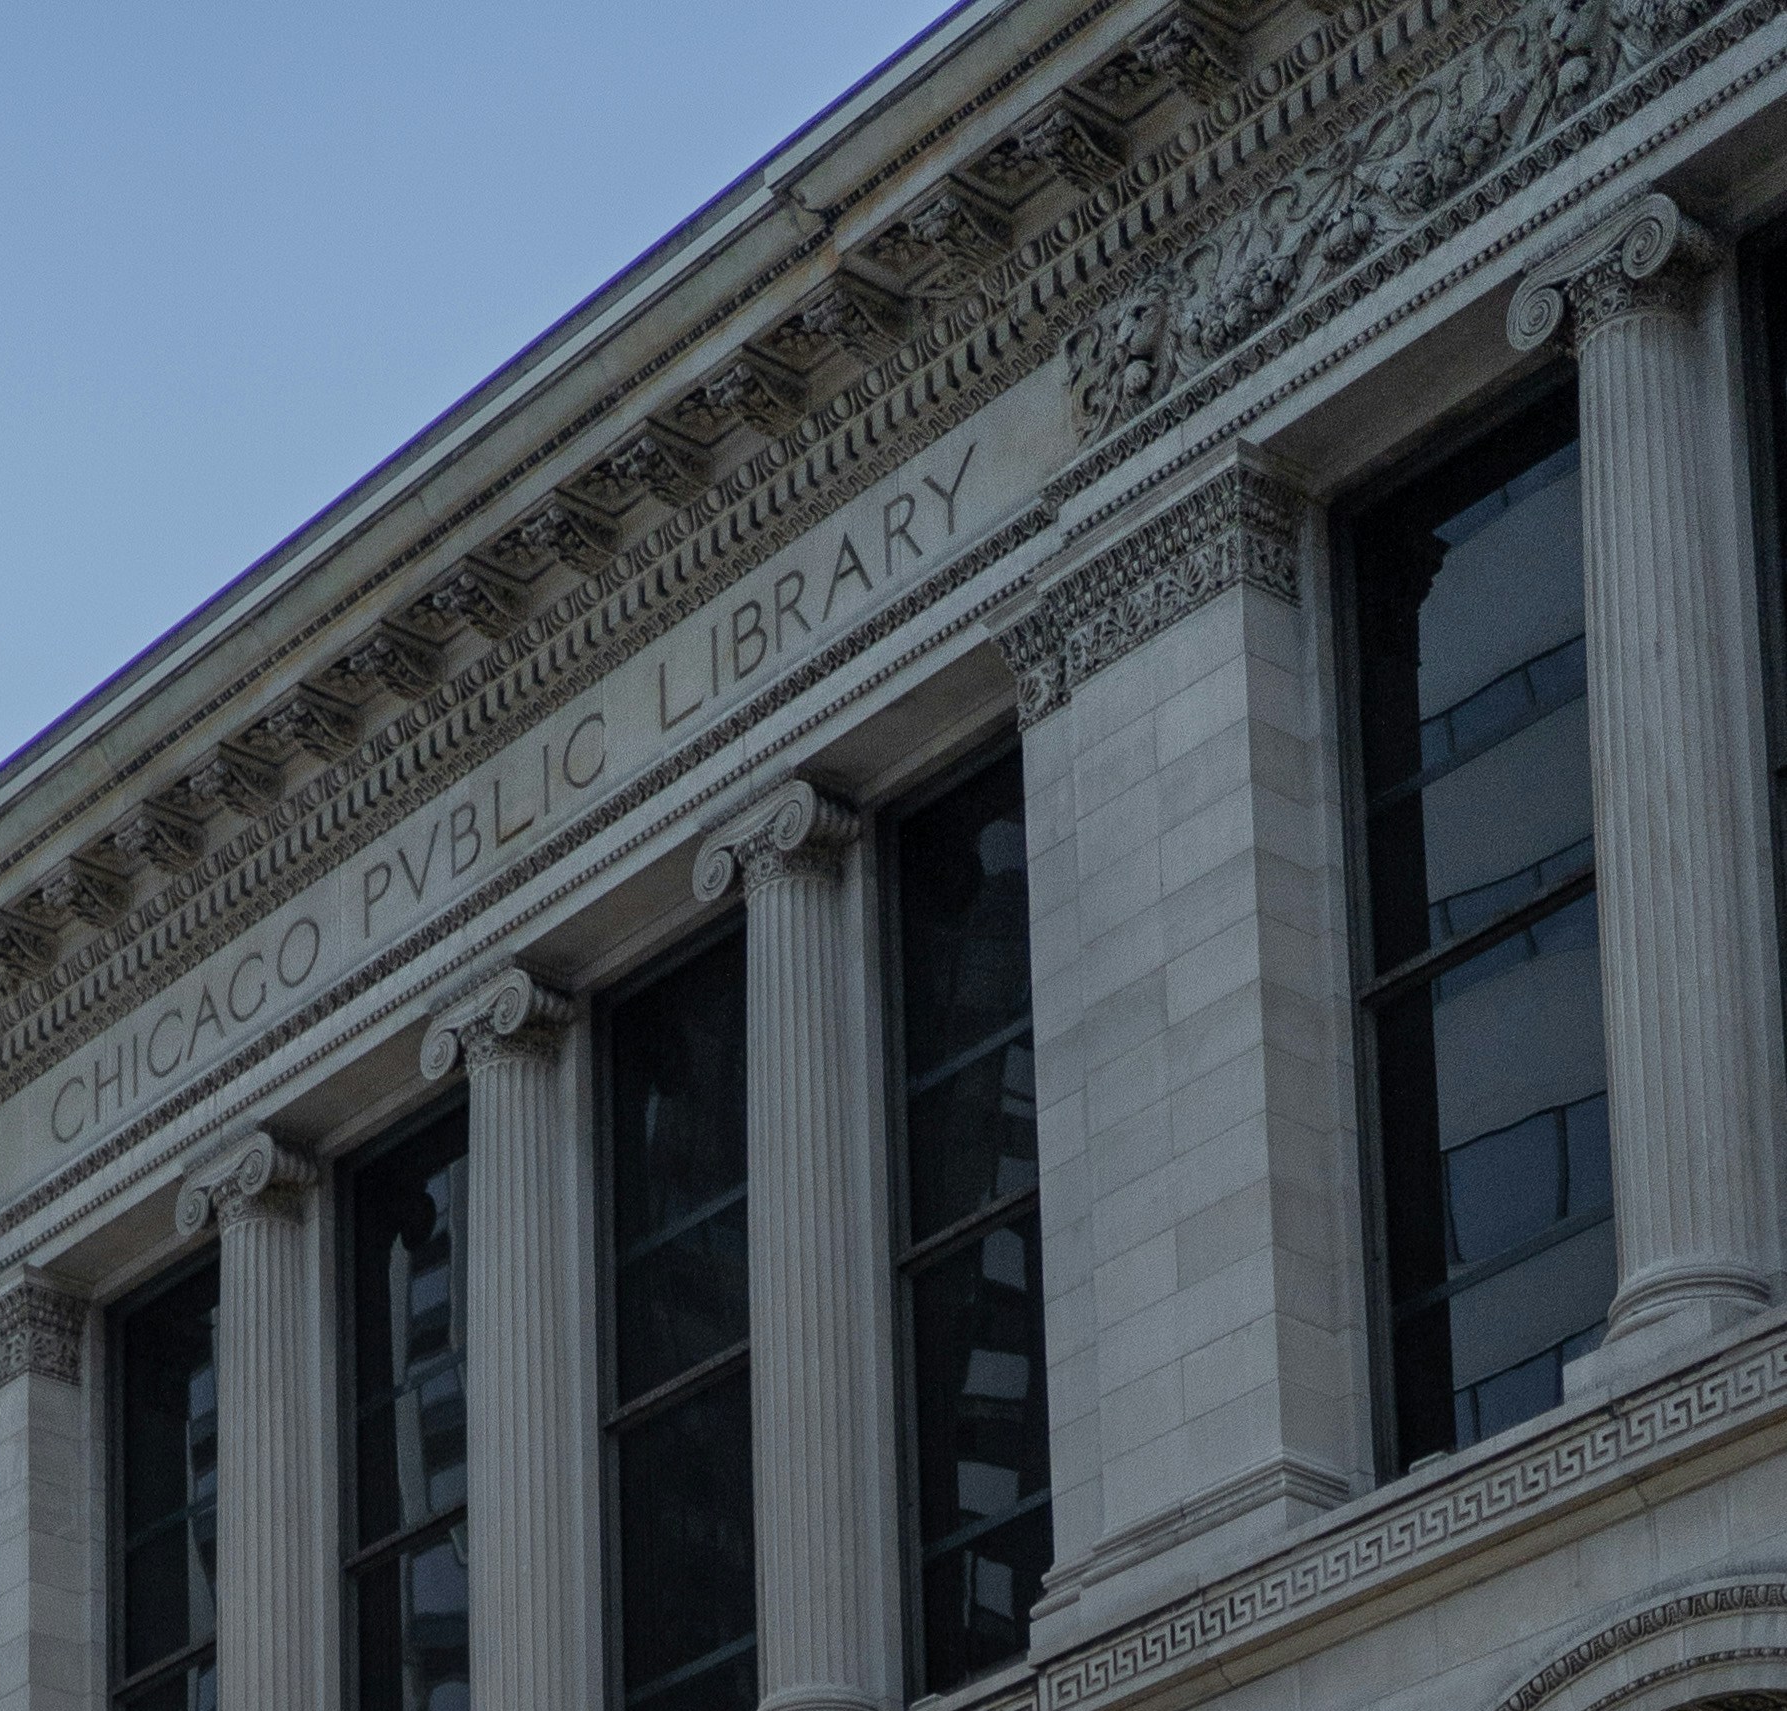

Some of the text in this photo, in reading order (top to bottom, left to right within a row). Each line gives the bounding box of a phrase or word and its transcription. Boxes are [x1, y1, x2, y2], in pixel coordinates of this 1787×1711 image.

[50, 442, 980, 1144] CHICAGO PVBLIC LIBRARY
